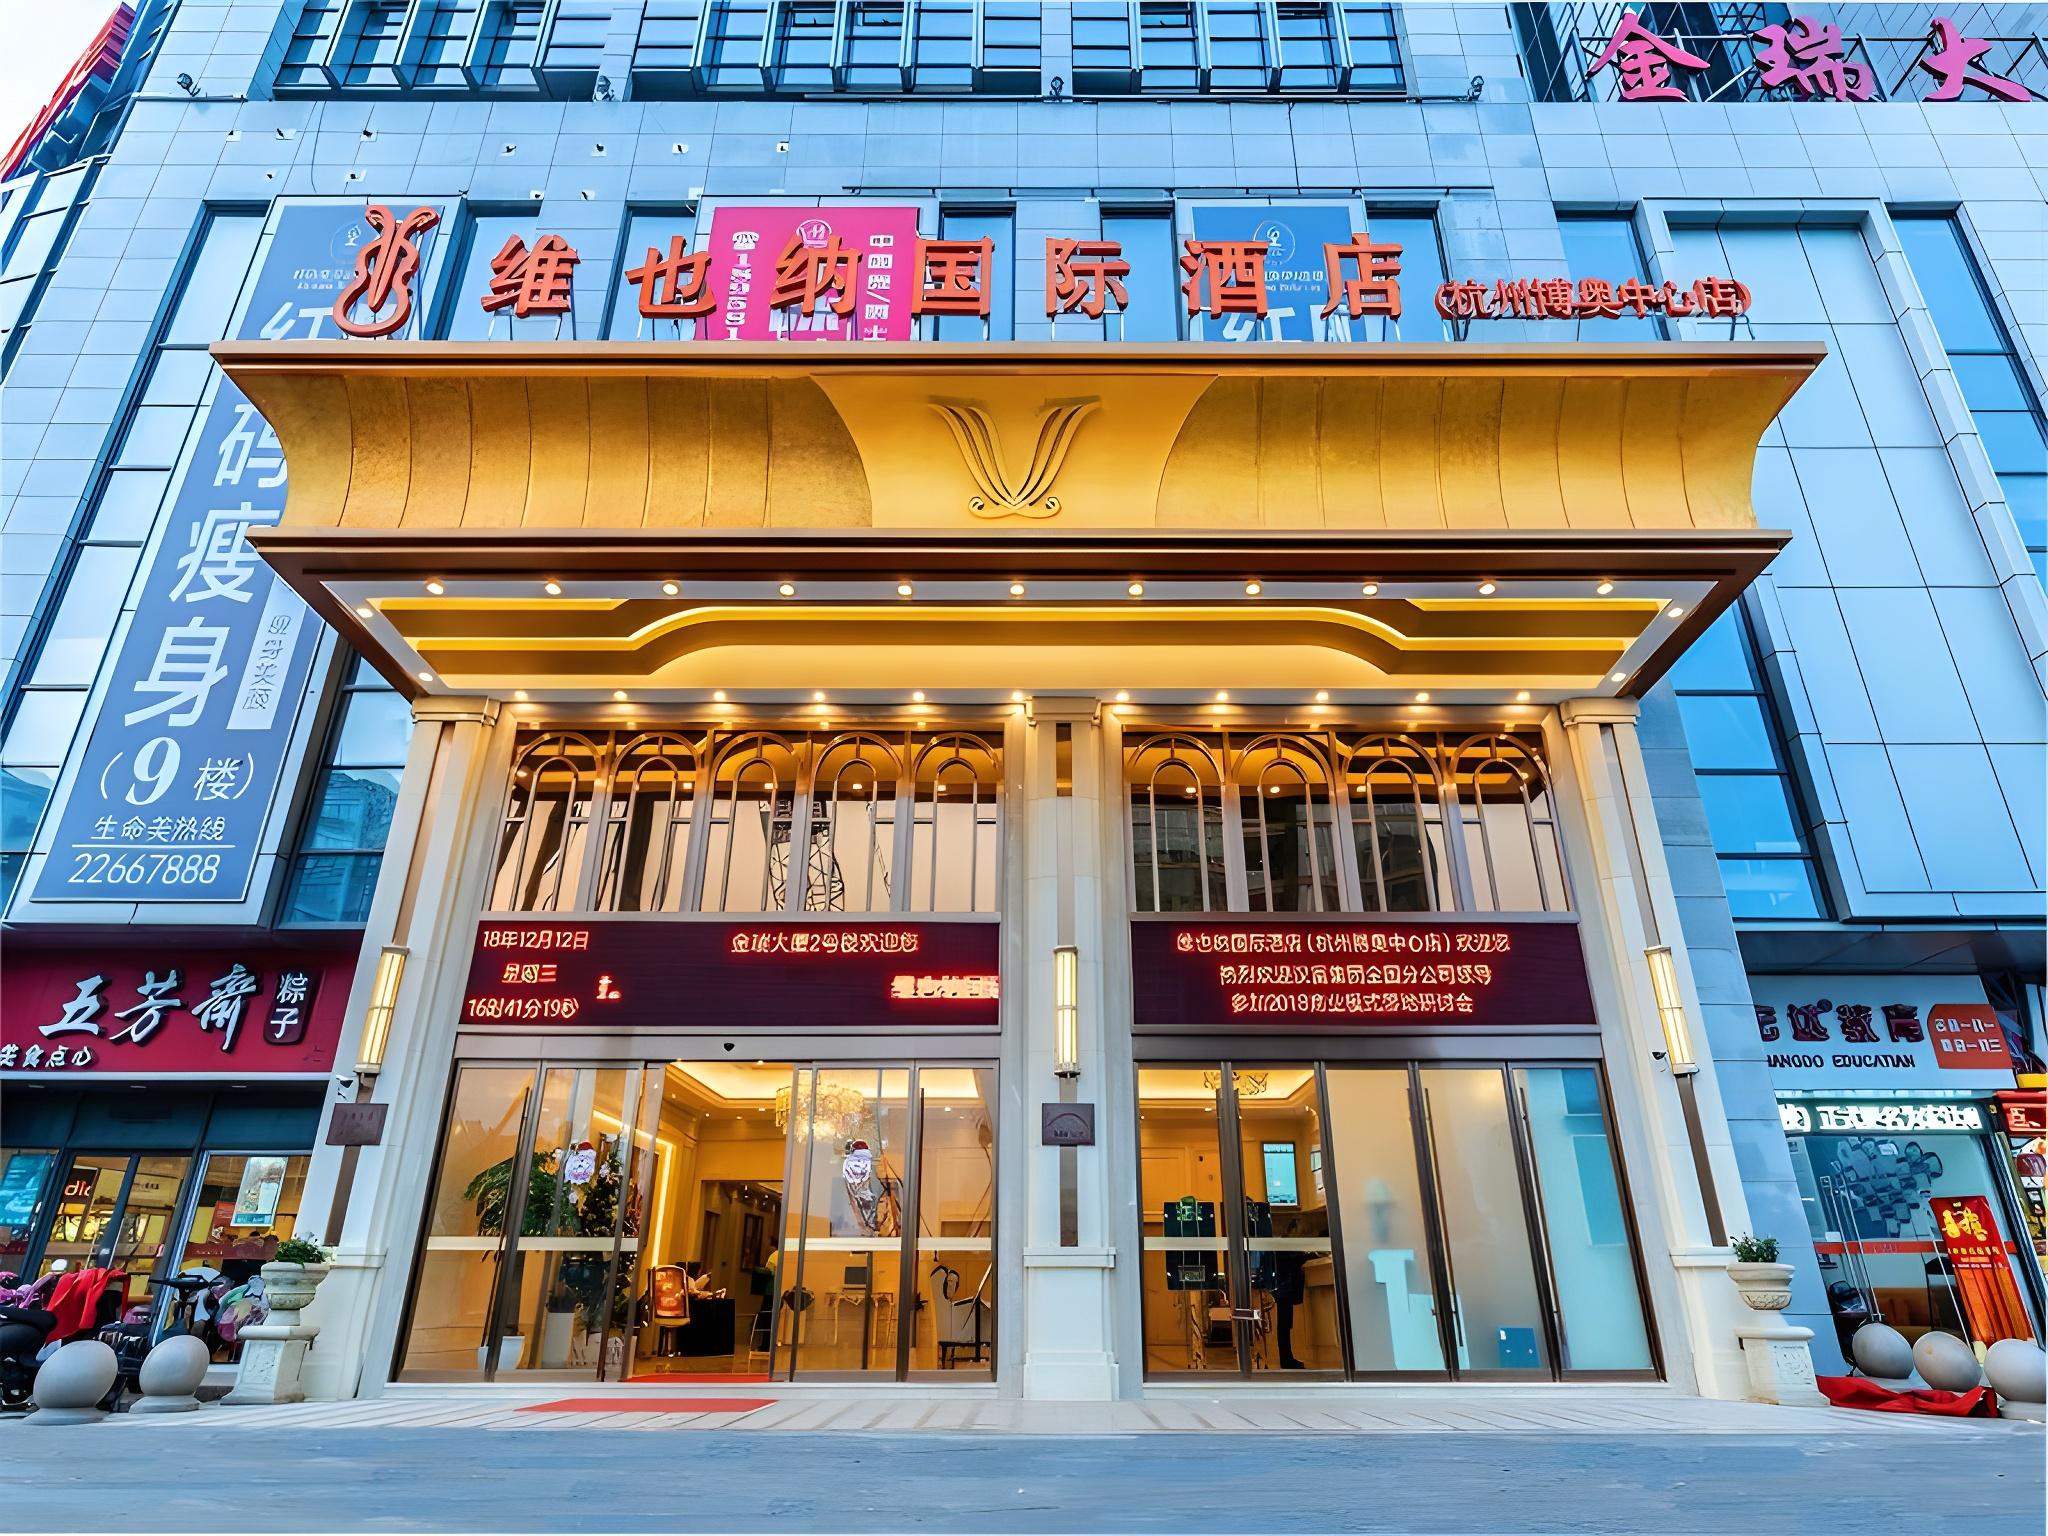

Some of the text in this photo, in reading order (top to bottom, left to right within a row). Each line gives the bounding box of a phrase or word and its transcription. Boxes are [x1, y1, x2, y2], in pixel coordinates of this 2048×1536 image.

[1586, 8, 2032, 102] 金瑞大
[481, 232, 1403, 319] 维也纳国际酒店
[67, 852, 221, 884] 22667888
[483, 930, 589, 950] 18年12月12日
[269, 972, 309, 1039] 粽子
